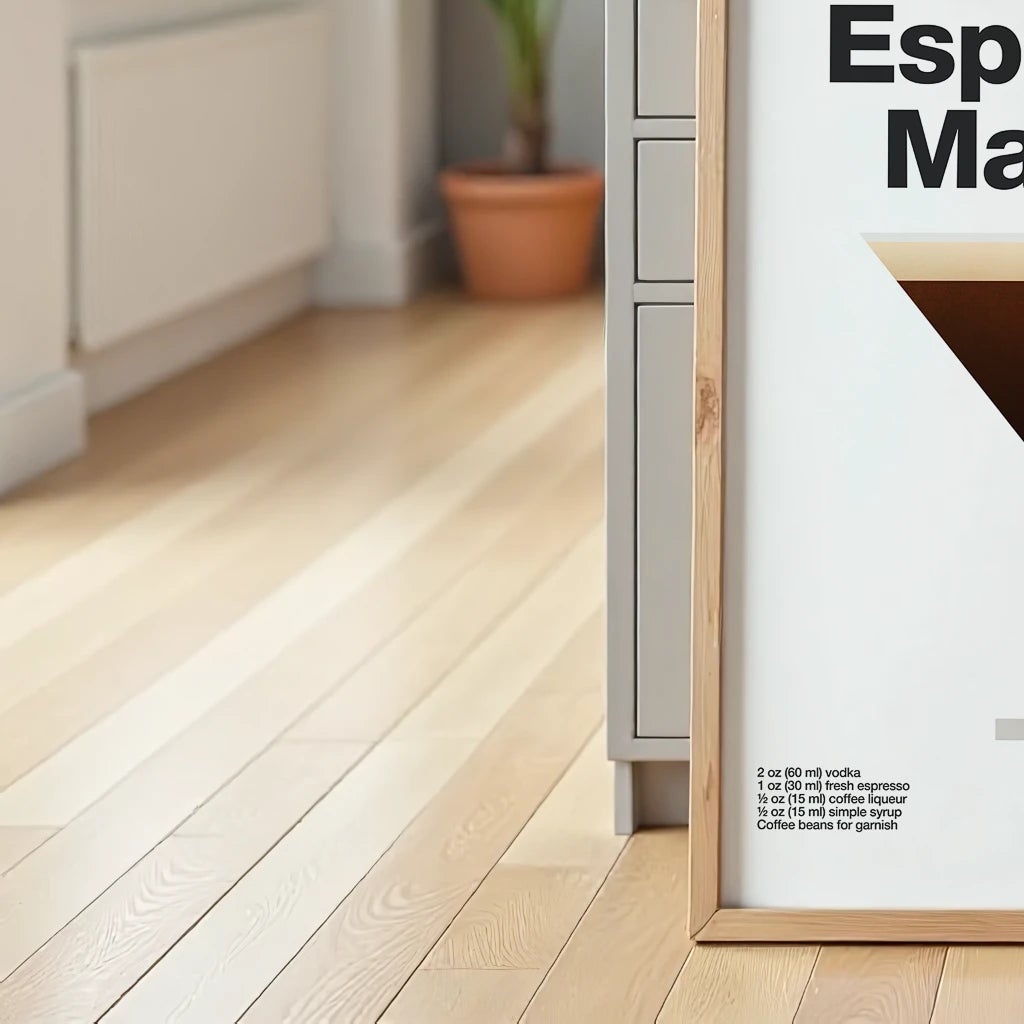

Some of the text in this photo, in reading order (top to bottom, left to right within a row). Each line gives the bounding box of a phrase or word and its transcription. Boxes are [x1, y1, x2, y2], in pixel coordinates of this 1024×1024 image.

[757, 767, 861, 780] 2 oz (60 ml) vodka
[758, 780, 910, 793] 1 oz (30 ml) fresh espresso
[771, 796, 785, 804] oz
[787, 793, 806, 806] (15
[808, 793, 826, 806] ml)
[828, 793, 865, 804] coffee
[868, 793, 908, 806] liqueur
[771, 809, 785, 817] oz
[787, 806, 806, 819] (15
[808, 806, 826, 819] ml)
[828, 807, 867, 820] simple
[870, 809, 903, 820] syrup
[757, 819, 898, 833] Coffee beans for garnish
